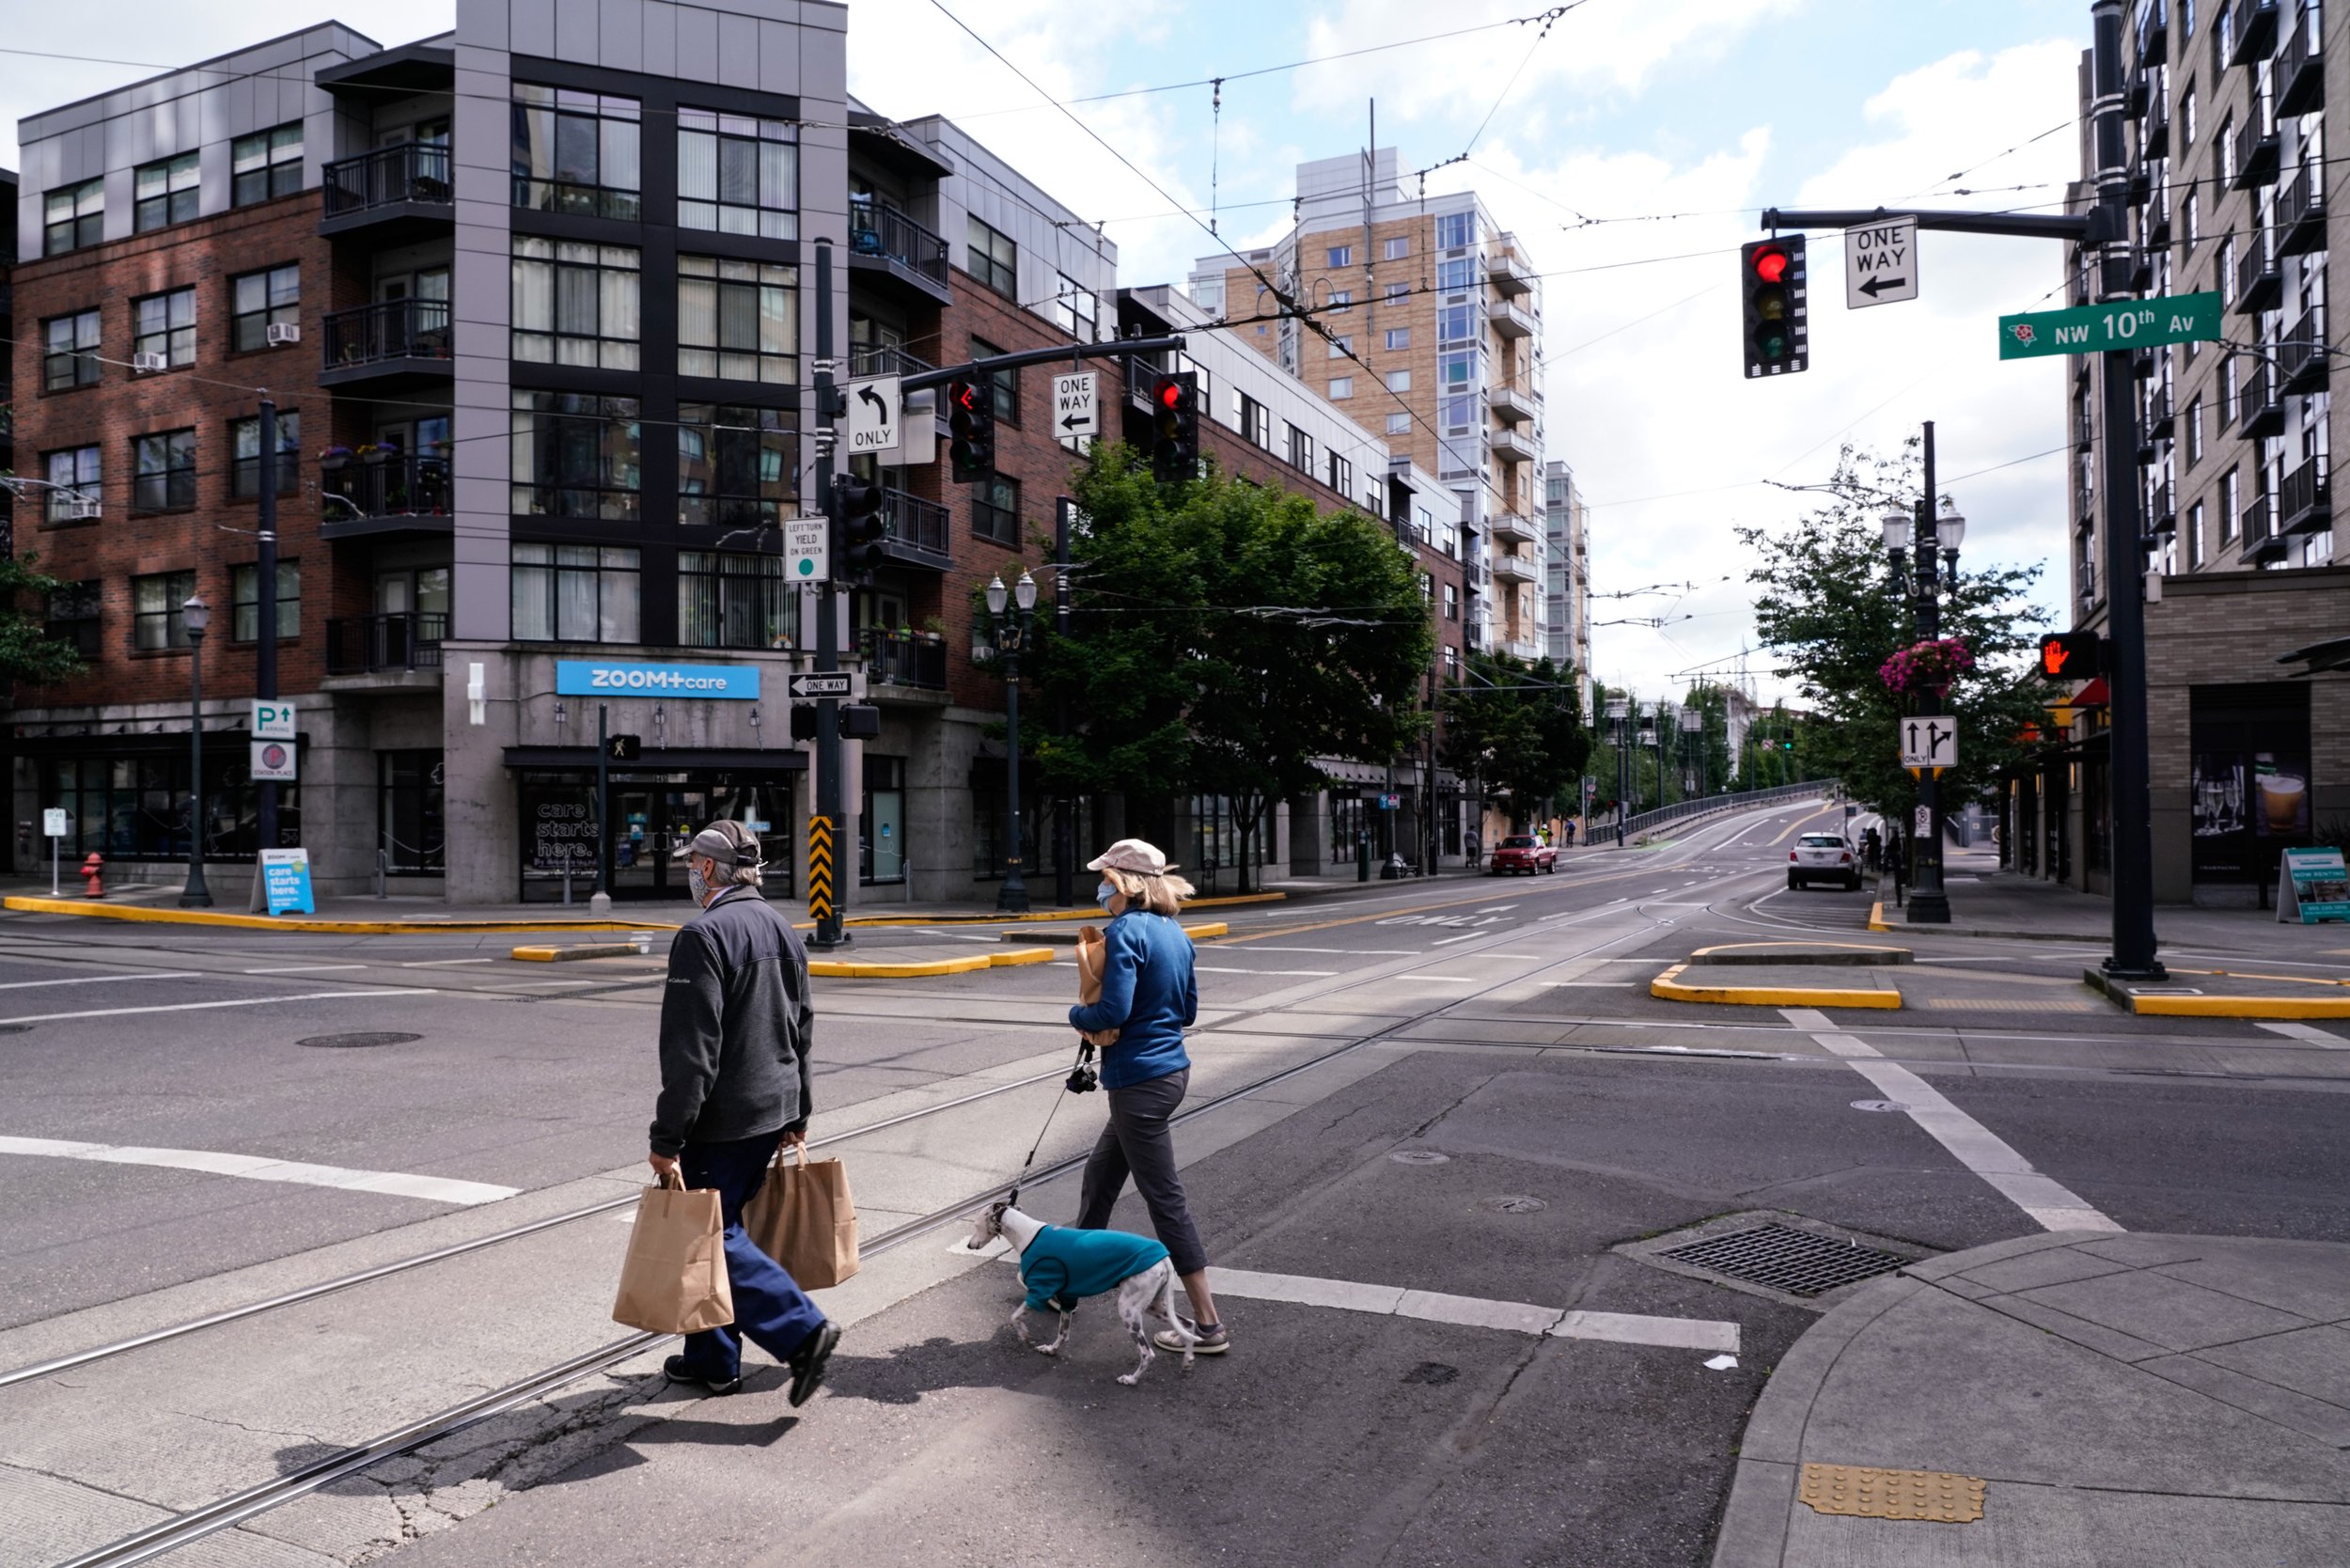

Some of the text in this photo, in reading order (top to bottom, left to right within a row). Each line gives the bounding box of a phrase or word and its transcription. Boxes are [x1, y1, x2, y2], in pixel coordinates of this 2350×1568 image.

[1857, 226, 1904, 250] ONE
[1856, 246, 1906, 273] WAY
[2055, 308, 2194, 345] NW 10th Av
[1060, 377, 1090, 394] ONE
[1059, 394, 1090, 411] WAY
[855, 429, 891, 447] ONLY
[789, 523, 822, 532] LEFT TURN
[795, 534, 818, 544] YIELD
[790, 546, 822, 556] ON GREEN
[591, 669, 727, 690] ZOOM+care
[807, 680, 845, 691] ONE WAY
[1904, 755, 1927, 763] ONLY
[538, 804, 586, 818] care
[537, 821, 599, 837] starts
[538, 839, 592, 857] here.
[268, 868, 292, 876] care
[2313, 870, 2345, 878] RENTING
[270, 876, 300, 886] starts
[270, 886, 299, 895] here.
[1375, 915, 1515, 927] ONLY
